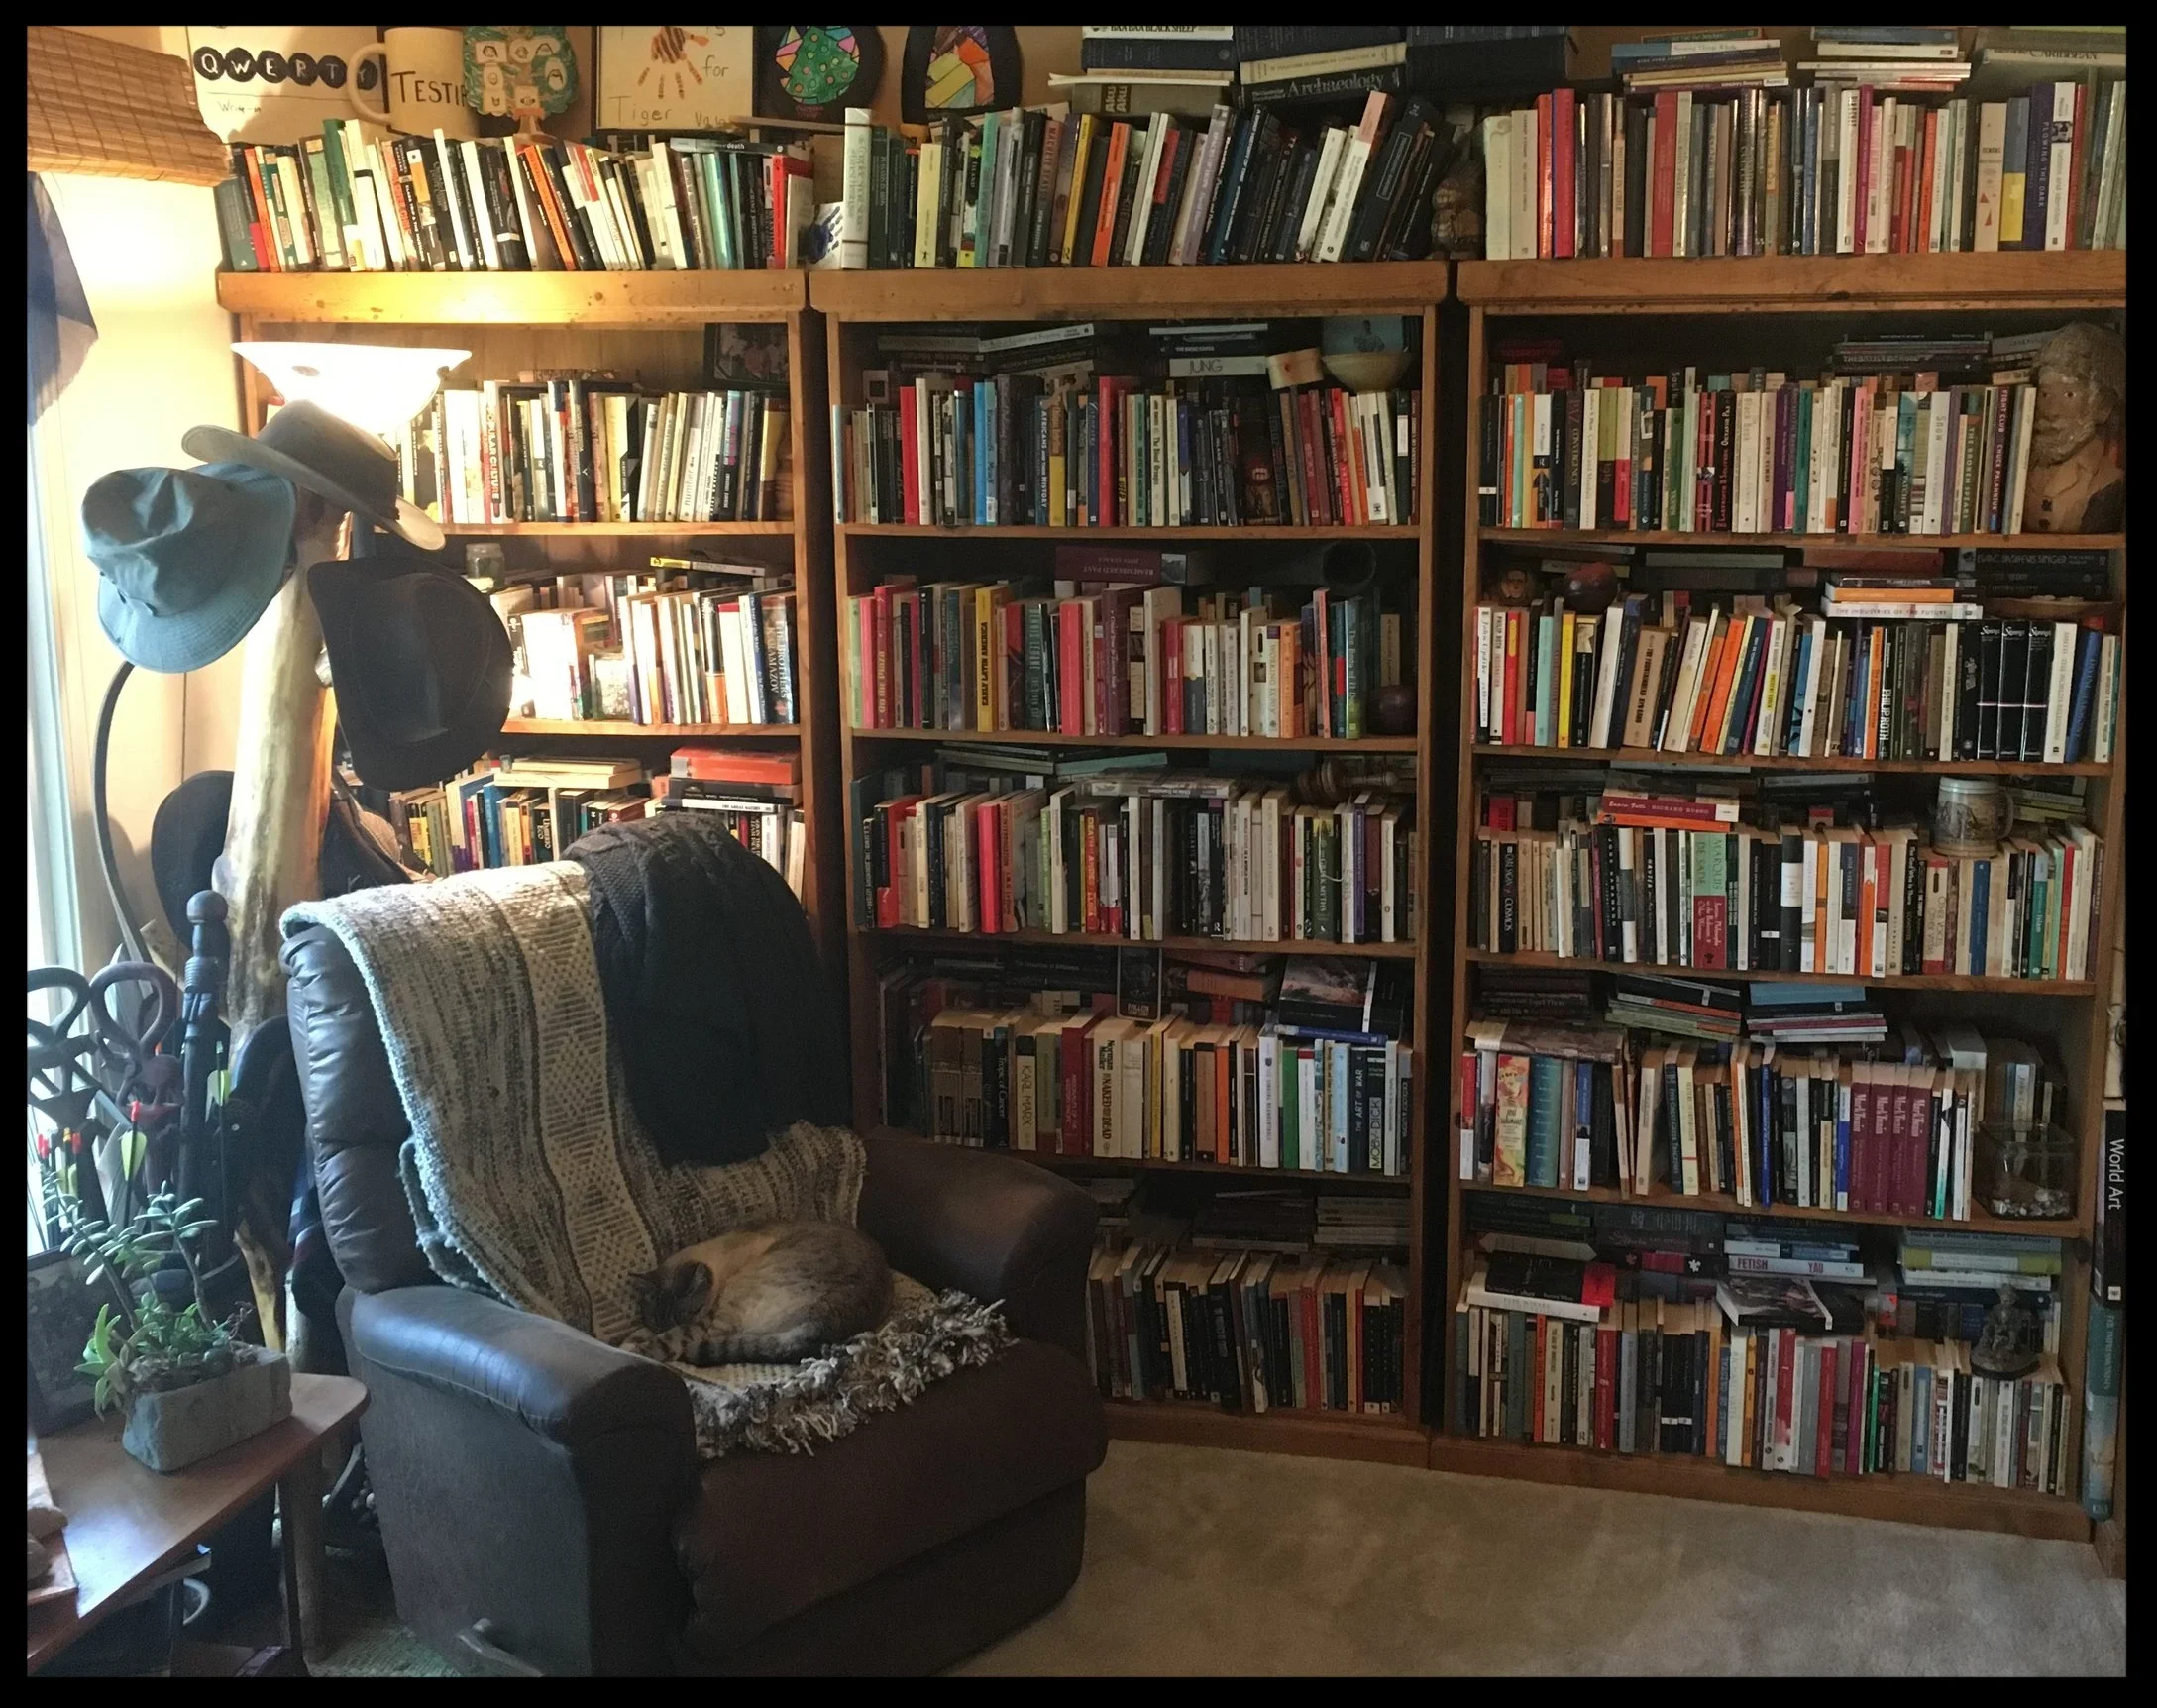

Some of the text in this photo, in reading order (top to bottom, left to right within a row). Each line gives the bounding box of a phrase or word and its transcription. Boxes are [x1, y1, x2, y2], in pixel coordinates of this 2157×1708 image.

[702, 54, 729, 77] for
[1287, 74, 1385, 98] Archaeology
[608, 95, 673, 131] Tiger
[2039, 122, 2049, 161] PLOWING
[1189, 359, 1223, 374] JUNG
[1569, 399, 1579, 423] PAZ
[1999, 390, 2008, 411] FIGHT
[486, 407, 500, 500] POPULAR CULTURE
[1965, 448, 1974, 484] BROKEN
[1103, 566, 1153, 575] REMEMBERED
[767, 627, 779, 694] KARAMAZOV
[776, 621, 788, 698] THE BROTHERS
[2084, 659, 2097, 690] DIVINE
[1349, 671, 1355, 680] of
[1639, 659, 1653, 696] FOUNTAINHEAD
[1880, 689, 1892, 712] PHILIP
[1879, 713, 1890, 741] ROTH
[542, 818, 551, 849] UMBERTO
[1504, 853, 1513, 868] CARL
[1696, 842, 1707, 887] DE SADE
[1712, 839, 1722, 890] MARQUIS
[1504, 898, 1514, 932] COSMOS
[1925, 908, 1935, 955] OTHER VISTAS
[997, 1056, 1007, 1079] Tropic
[1098, 1046, 1108, 1071] Mailer
[998, 1090, 1007, 1119] Cancer
[1021, 1065, 1035, 1127] KARL MARX
[1101, 1078, 1112, 1140] NAKED DEAD
[1668, 1088, 1676, 1101] FIVE
[1669, 1102, 1677, 1121] GREAT
[1370, 1100, 1380, 1167] MOBY-DICK
[1670, 1121, 1678, 1139] GREEK
[2108, 1139, 2124, 1210] World Art
[1738, 1257, 1824, 1273] FETISH YAU
